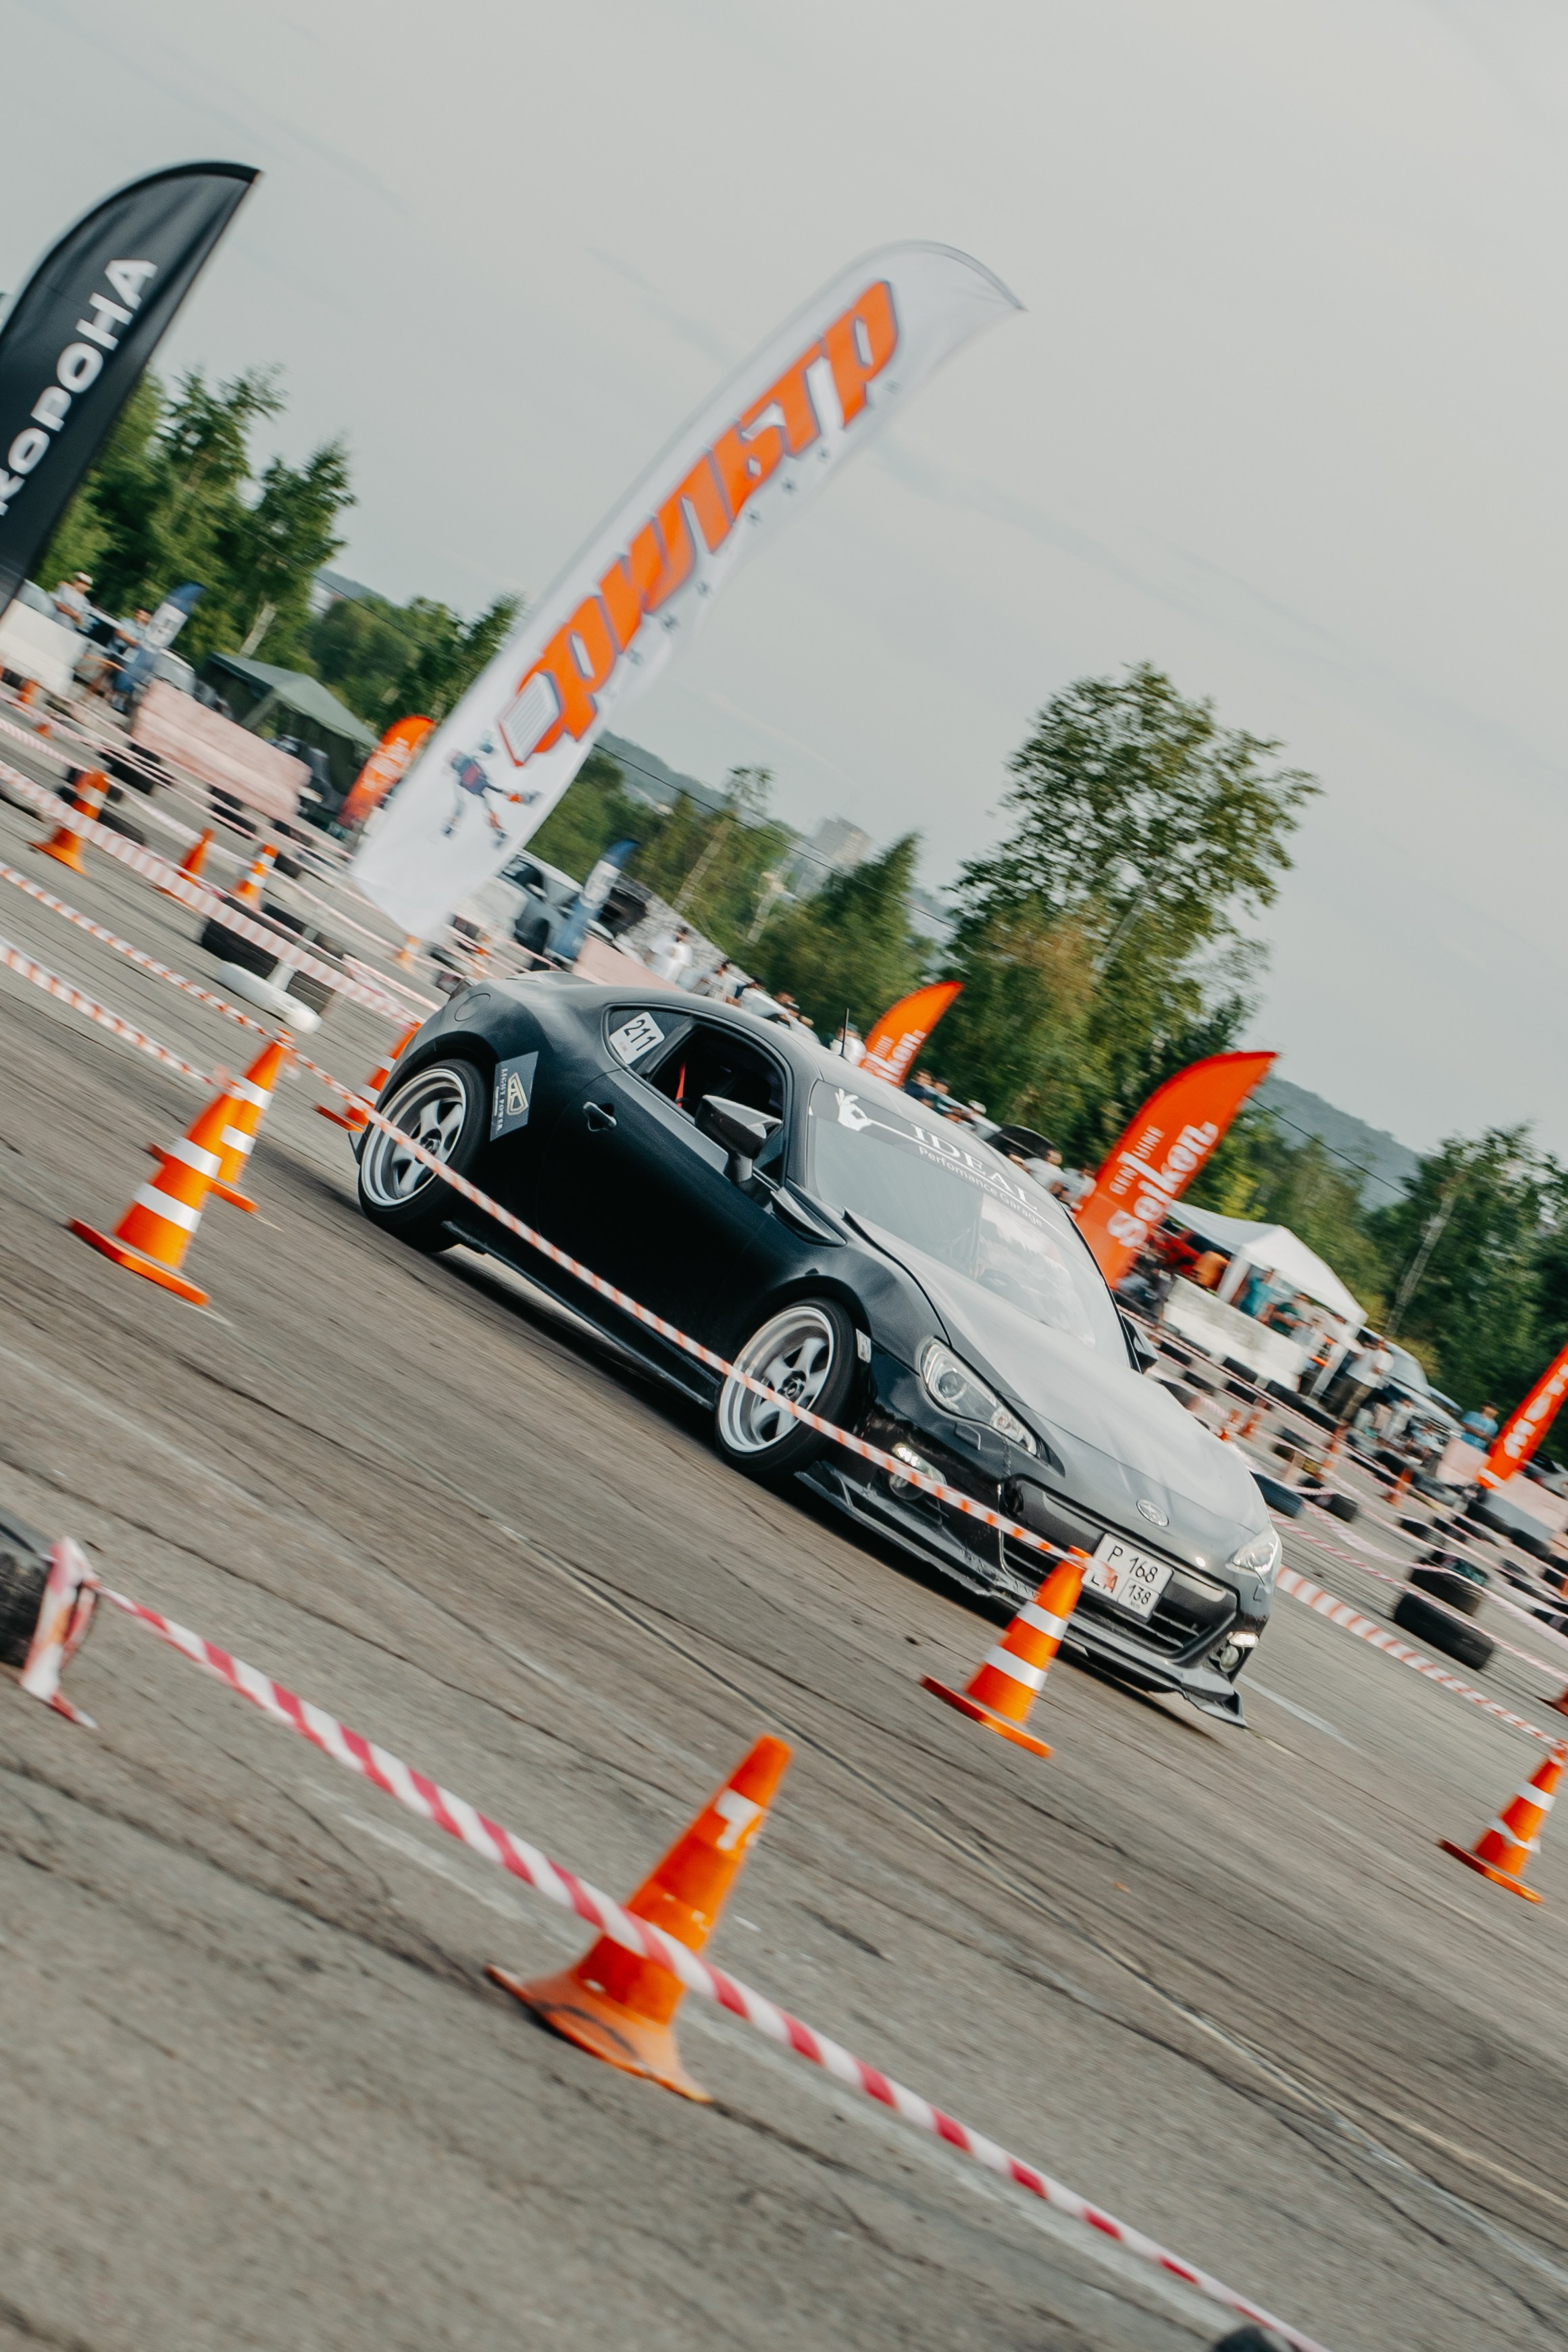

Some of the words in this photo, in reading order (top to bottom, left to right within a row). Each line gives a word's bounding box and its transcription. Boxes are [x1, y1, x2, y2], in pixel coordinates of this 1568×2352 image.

[624, 1019, 657, 1051] 211
[911, 1123, 1038, 1211] IDEAL
[1000, 1193, 1042, 1228] Garage
[1108, 1545, 1123, 1561] P
[1130, 1557, 1159, 1583] 168
[1129, 1584, 1152, 1605] 138
